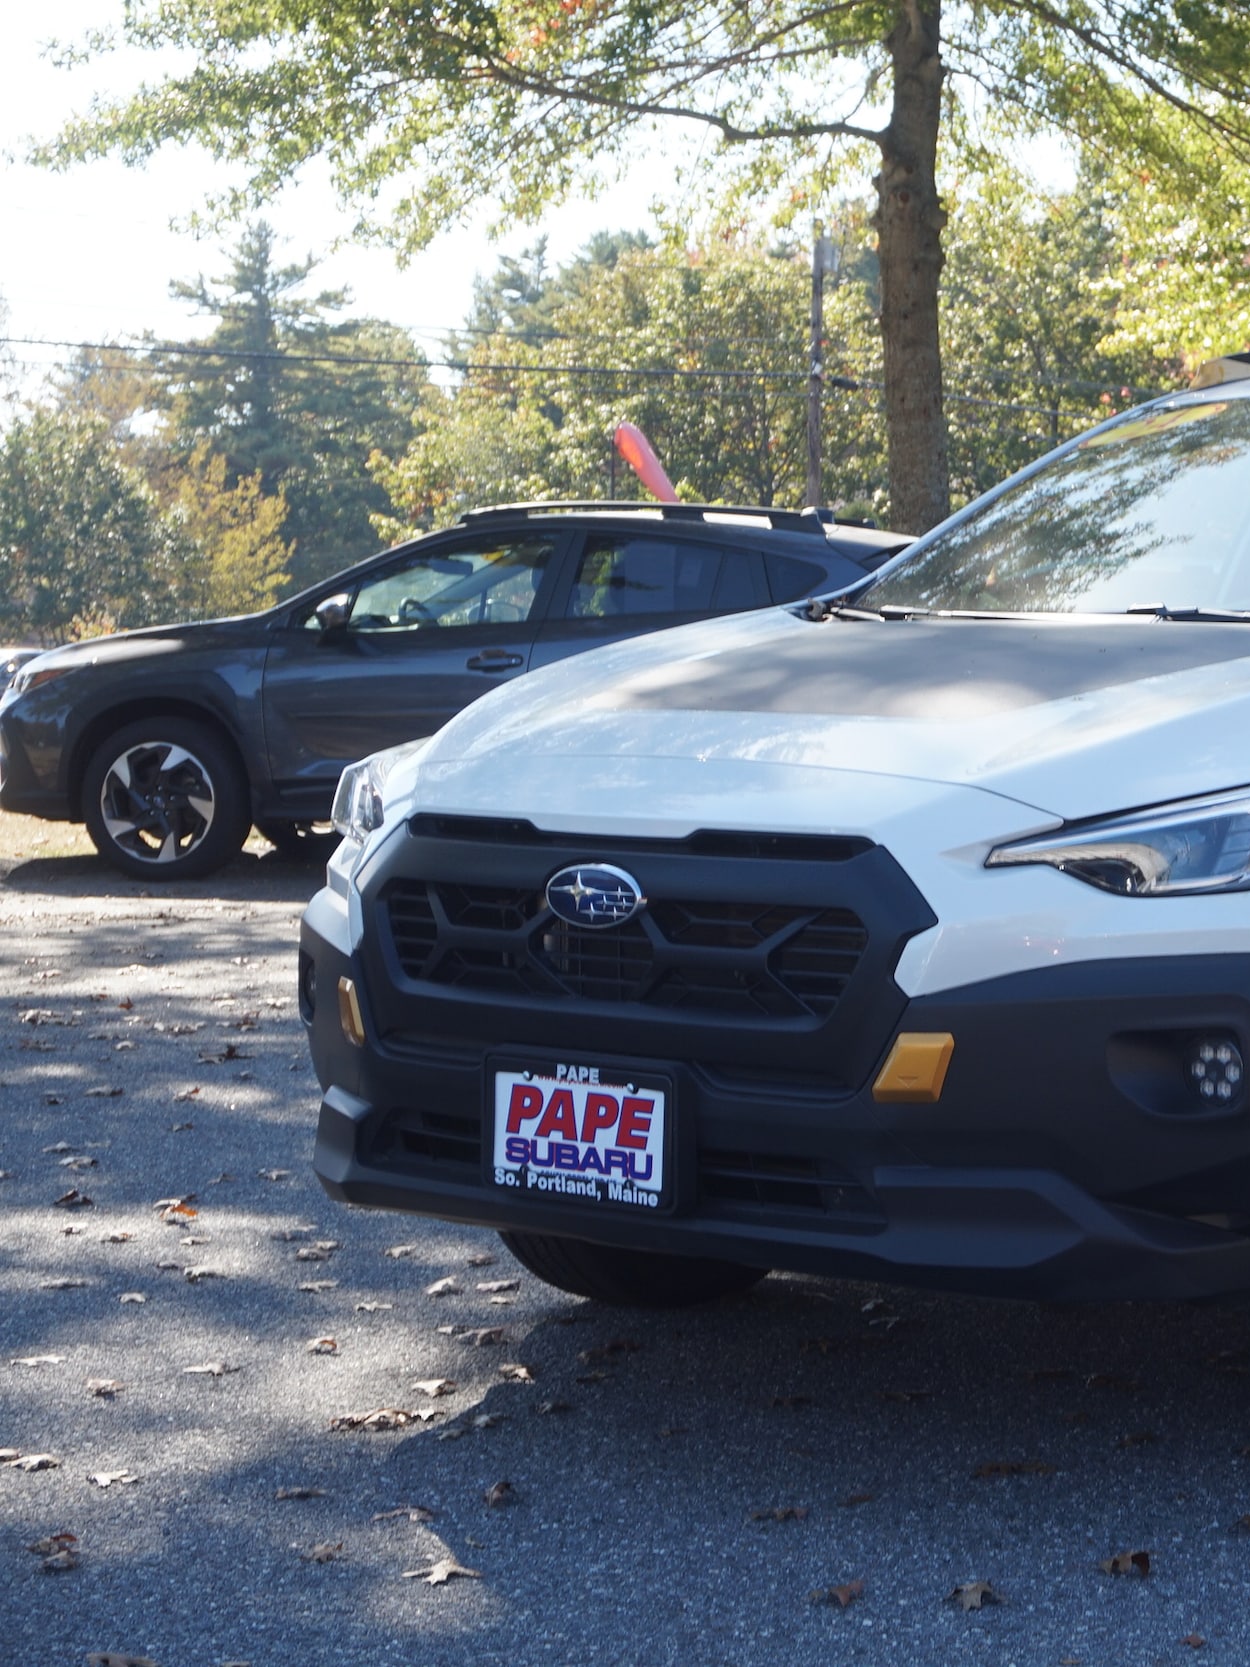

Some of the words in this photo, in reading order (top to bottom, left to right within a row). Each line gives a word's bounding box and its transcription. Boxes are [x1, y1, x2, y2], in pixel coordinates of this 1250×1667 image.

[556, 1063, 600, 1083] PAPE
[505, 1083, 655, 1150] PAPE
[505, 1136, 653, 1181] SUBARU
[494, 1168, 520, 1187] So.
[526, 1171, 601, 1202] Portland,
[608, 1182, 659, 1207] Maine
